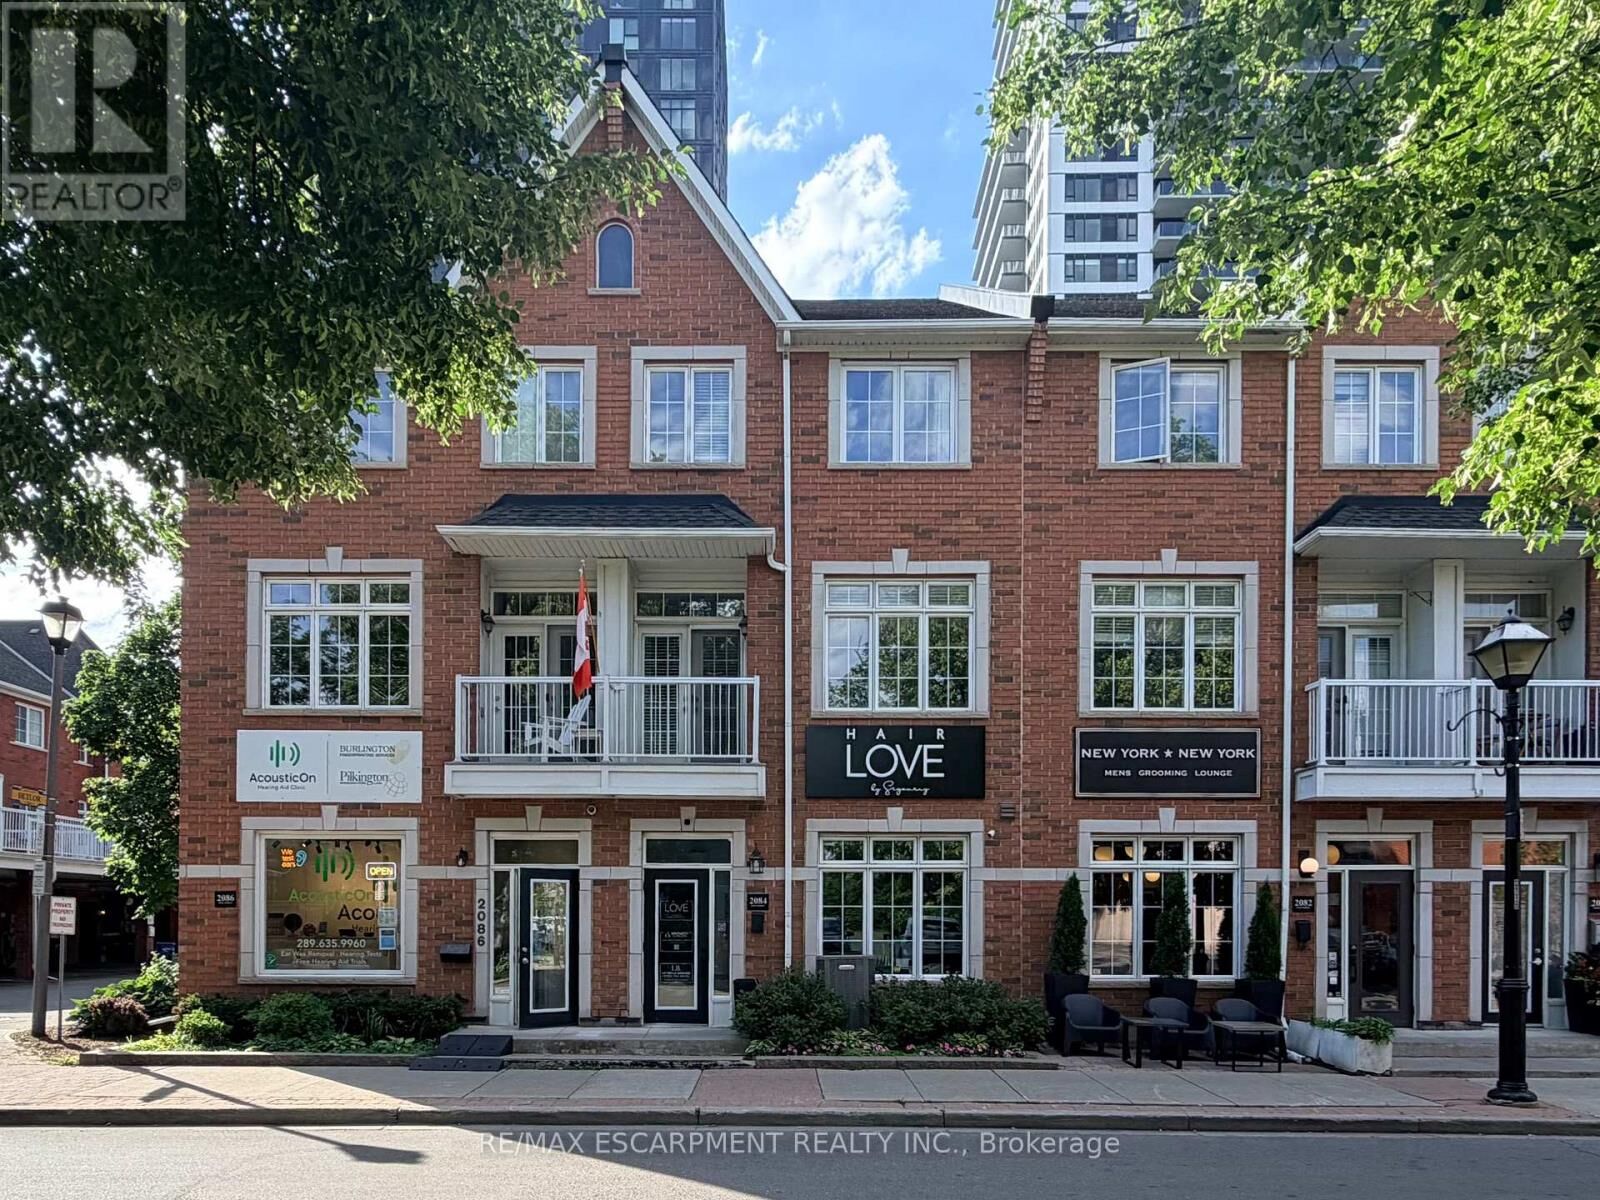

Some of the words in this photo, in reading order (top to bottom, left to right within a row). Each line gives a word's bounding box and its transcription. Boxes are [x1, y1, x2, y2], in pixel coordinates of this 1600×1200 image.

[846, 728, 945, 740] HAIR
[339, 745, 396, 753] BURLINGTON
[1081, 749, 1116, 759] NEW
[1121, 749, 1159, 759] YORK
[1178, 749, 1213, 759] NEW
[1217, 749, 1256, 759] YORK
[846, 744, 945, 779] LOVE
[249, 772, 316, 783] AcousticOn
[340, 770, 389, 785] Pilkington
[1104, 769, 1132, 777] MENS
[1138, 769, 1188, 777] GROOMING
[1194, 769, 1233, 777] LOUNGE
[369, 866, 394, 876] OPEN
[664, 903, 689, 913] LOVE
[1294, 899, 1313, 907] 2082
[477, 898, 486, 947] 2086
[296, 938, 367, 949] 289.635.9960
